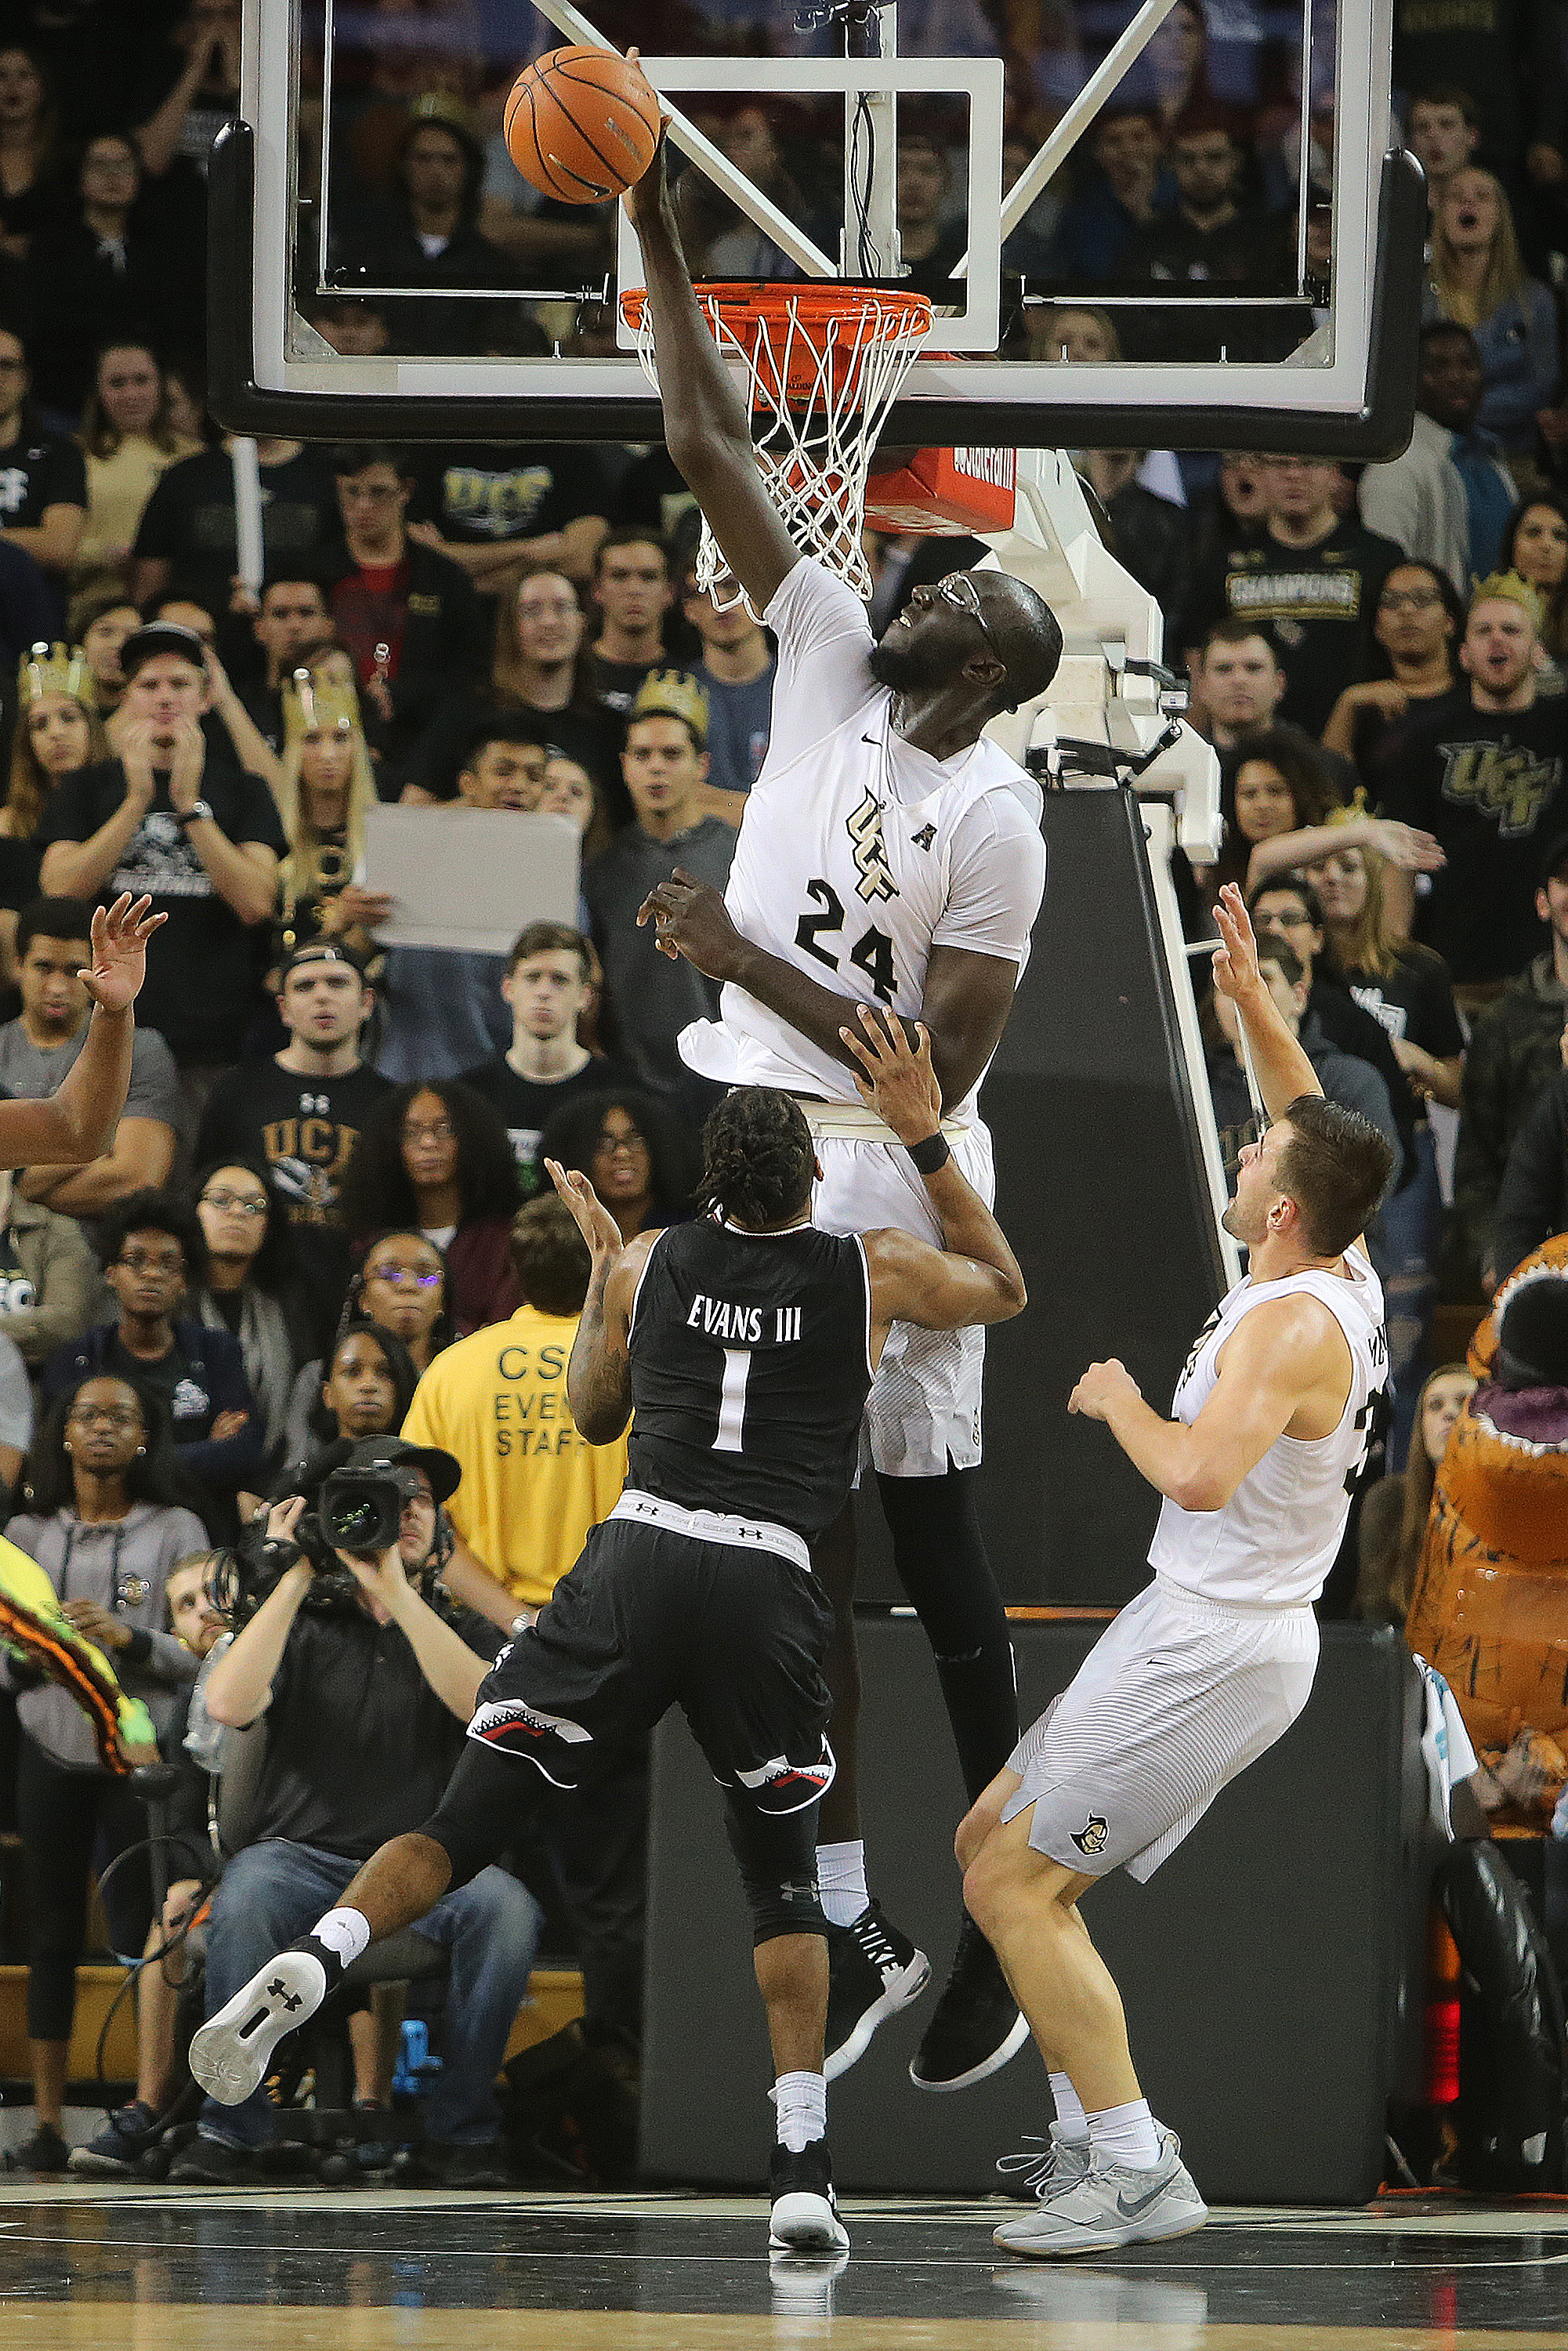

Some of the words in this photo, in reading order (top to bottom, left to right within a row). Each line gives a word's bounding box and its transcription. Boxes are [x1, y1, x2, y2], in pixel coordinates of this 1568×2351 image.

[1440, 740, 1559, 835] UCF
[846, 784, 900, 905] UCF
[794, 878, 899, 1009] 24
[686, 1294, 762, 1342] EVANS
[775, 1306, 802, 1342] III
[497, 1428, 586, 1457] STAF
[710, 1346, 751, 1453] 1
